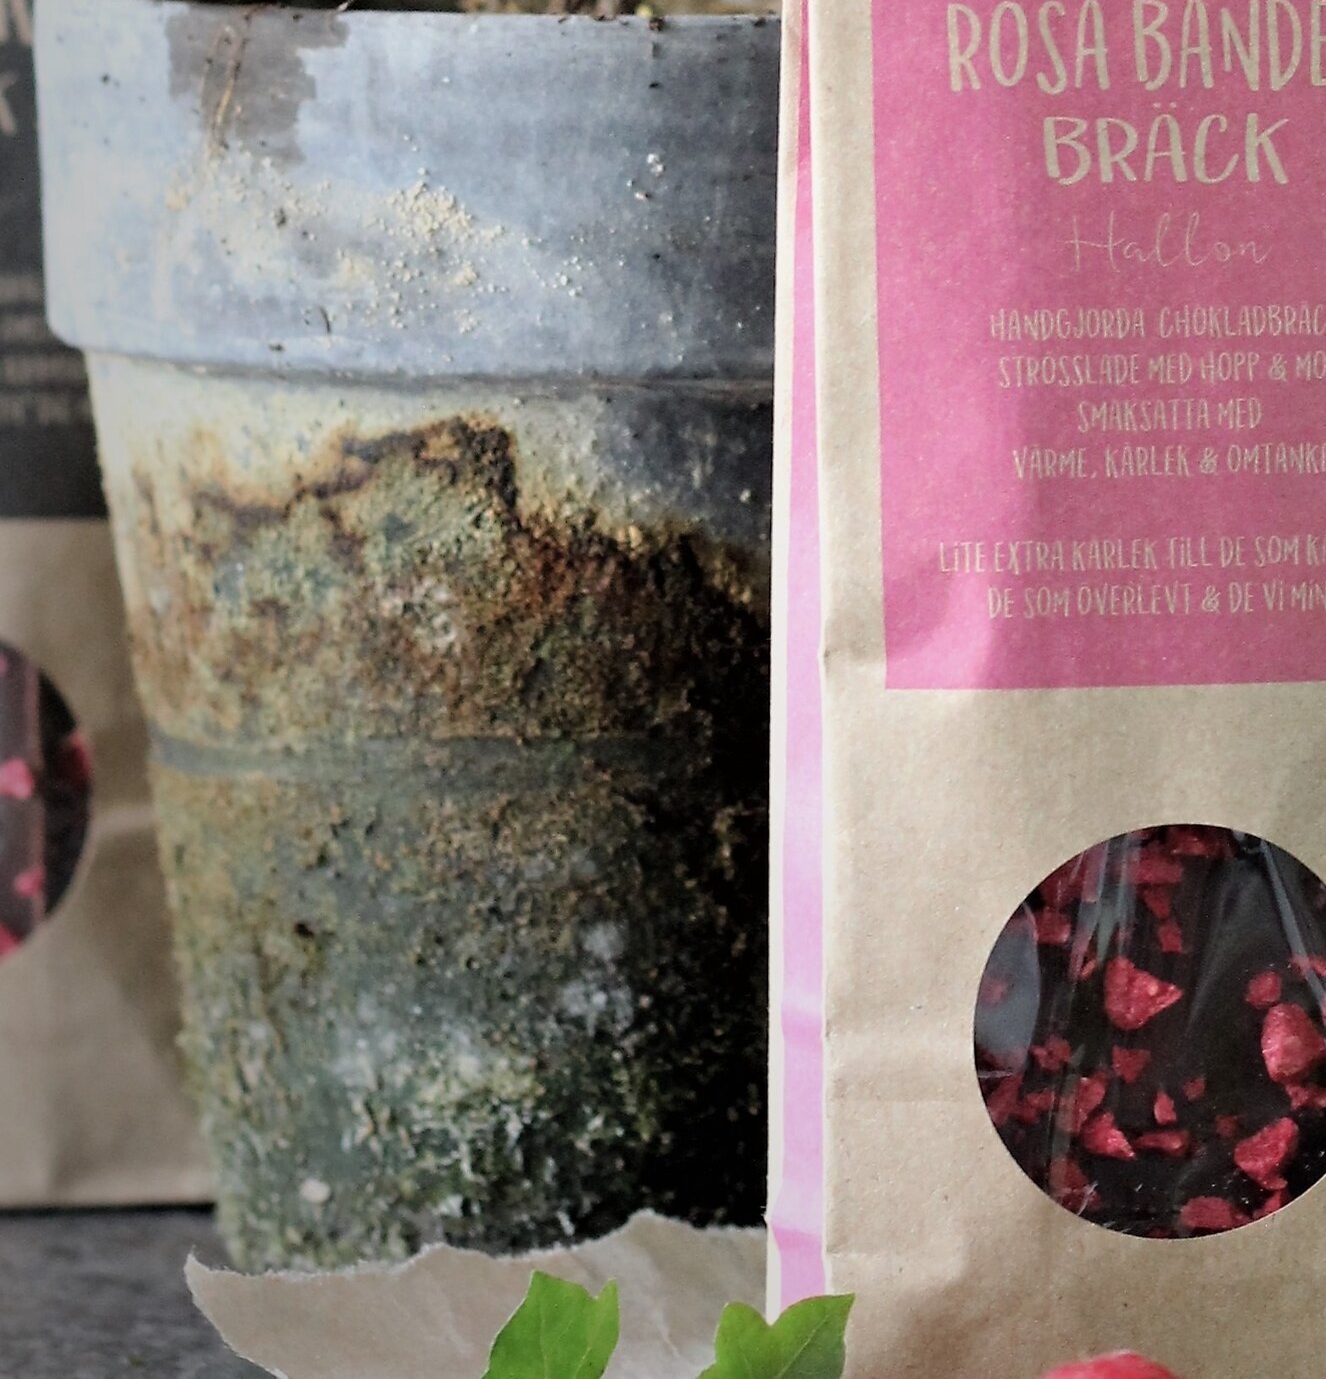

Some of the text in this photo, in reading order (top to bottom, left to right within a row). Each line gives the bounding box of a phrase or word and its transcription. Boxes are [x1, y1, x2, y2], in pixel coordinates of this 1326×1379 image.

[1043, 102, 1290, 186] BRÄCK
[1062, 209, 1272, 274] Hallon
[989, 307, 1146, 341] HANDGJORDA
[1148, 353, 1192, 385] MED
[1200, 351, 1260, 383] HOPP
[1268, 353, 1288, 382] &
[1077, 397, 1263, 433] SMAKSATTA MED
[1200, 447, 1219, 474] &
[995, 539, 1064, 575] EXTRA
[1220, 536, 1245, 567] DE
[1255, 534, 1299, 567] SOM
[988, 587, 1014, 619] DE
[1024, 586, 1070, 619] SOM
[1202, 585, 1221, 614] &
[1229, 582, 1254, 614] DE
